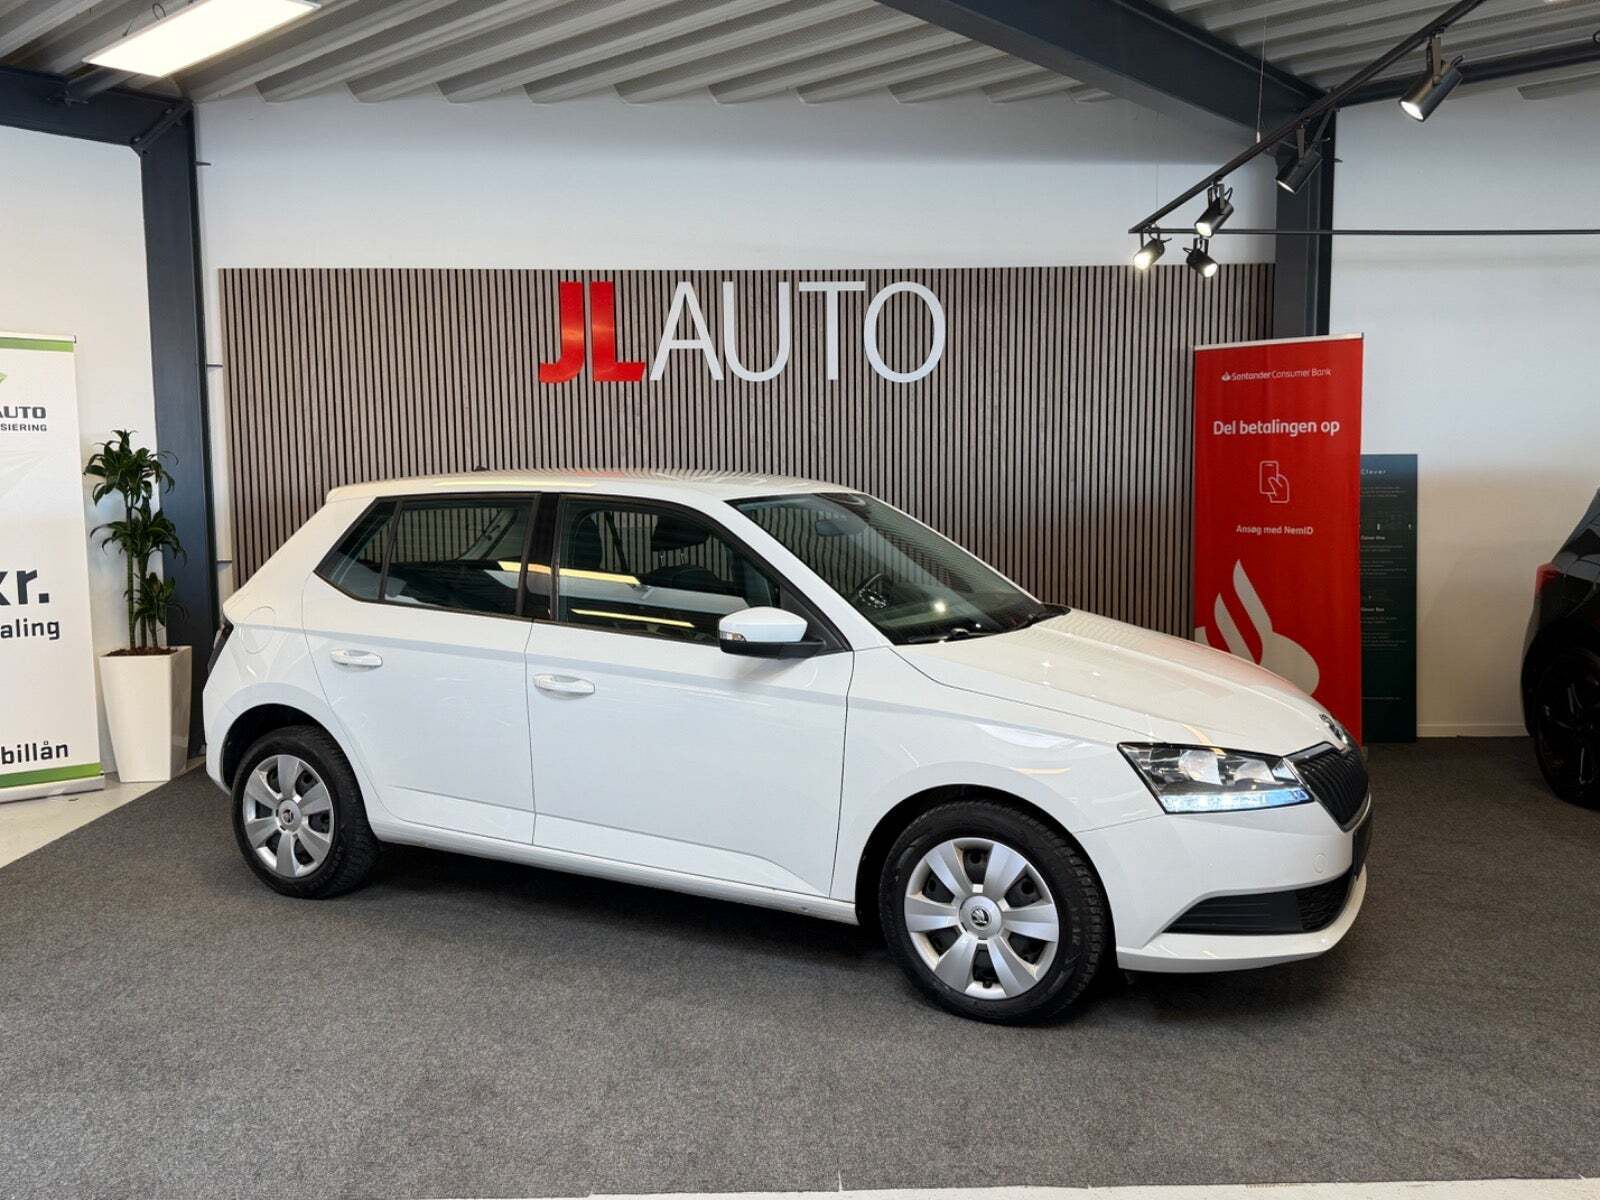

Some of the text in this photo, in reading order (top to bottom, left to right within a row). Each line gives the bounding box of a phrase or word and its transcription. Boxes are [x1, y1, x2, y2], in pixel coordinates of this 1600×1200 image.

[538, 281, 946, 383] JL AUTO
[1213, 419, 1340, 437] Del betalingen op
[1263, 526, 1282, 534] med
[0, 618, 60, 641] aling
[1, 740, 69, 765] billån
